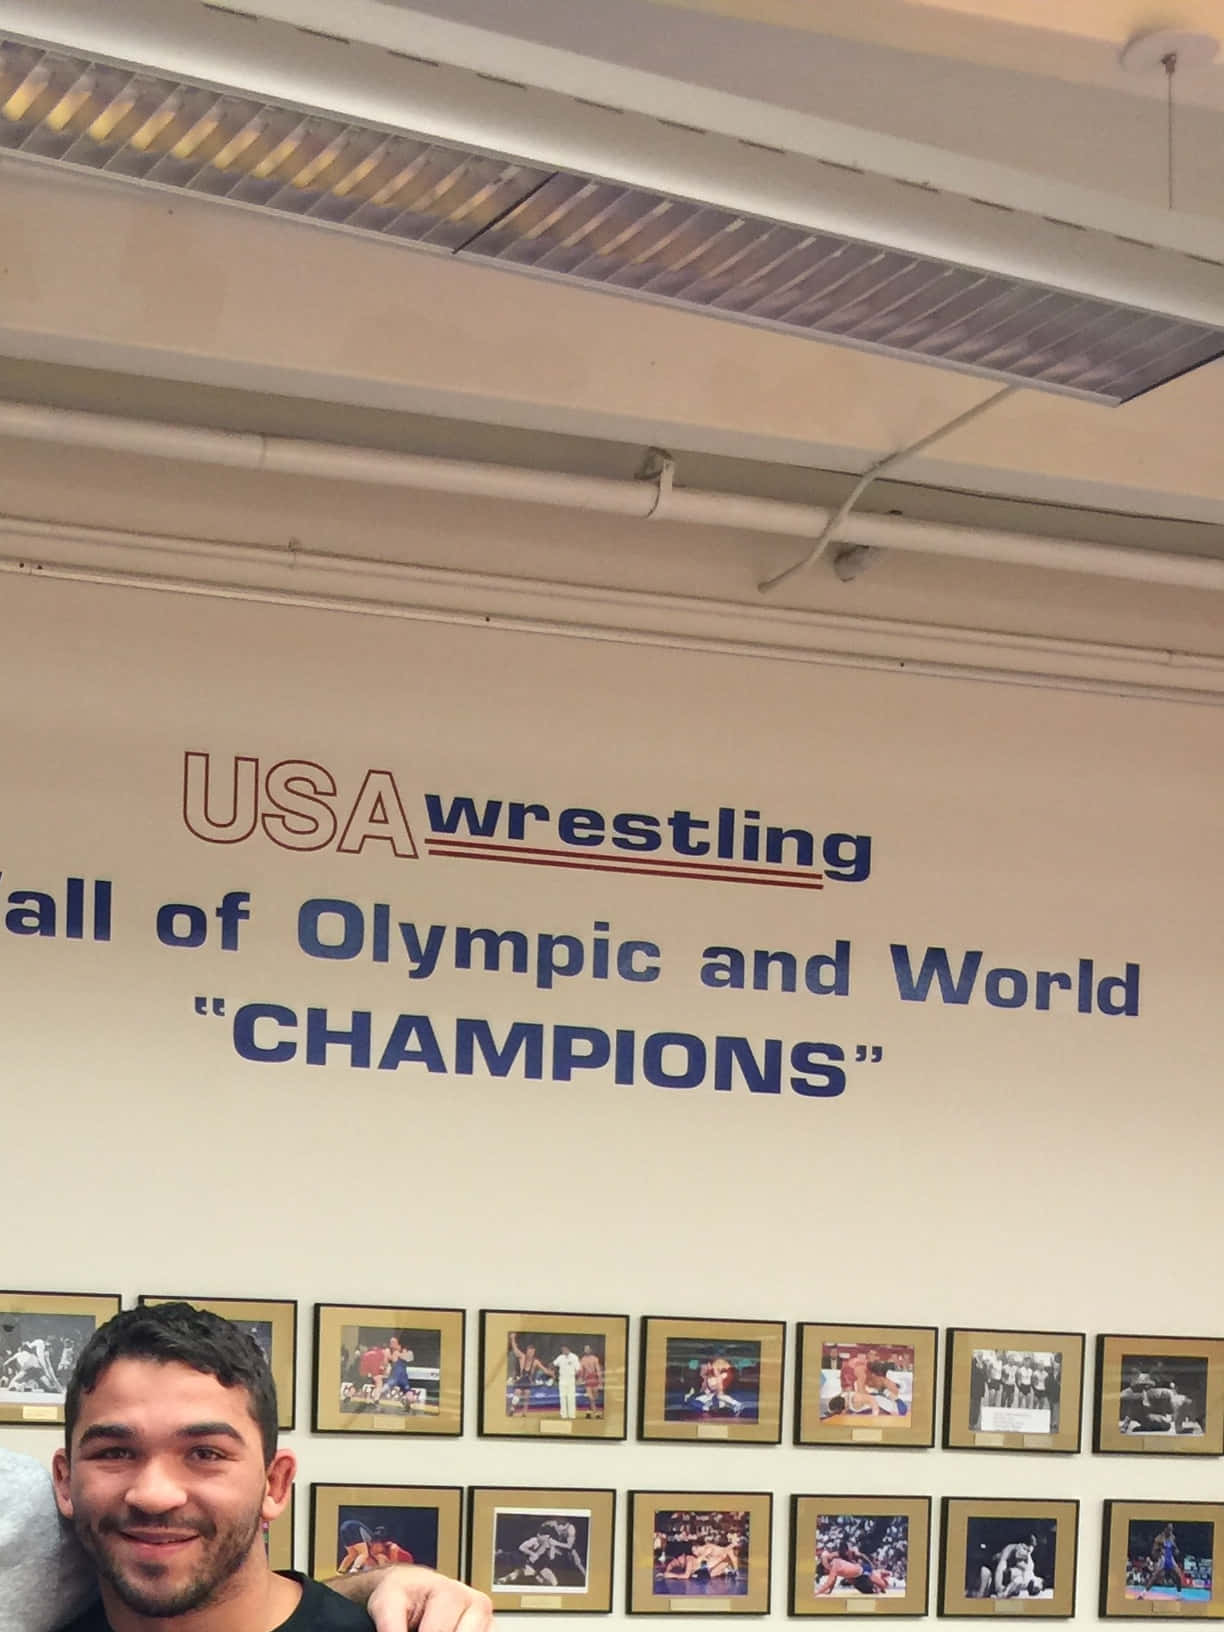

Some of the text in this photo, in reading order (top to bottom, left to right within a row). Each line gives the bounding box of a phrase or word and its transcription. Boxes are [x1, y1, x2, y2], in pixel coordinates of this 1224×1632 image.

[181, 750, 874, 883] USA wrestling
[155, 891, 252, 951] of
[296, 897, 663, 991] Olympic
[699, 938, 852, 996] and
[890, 942, 1142, 1018] World
